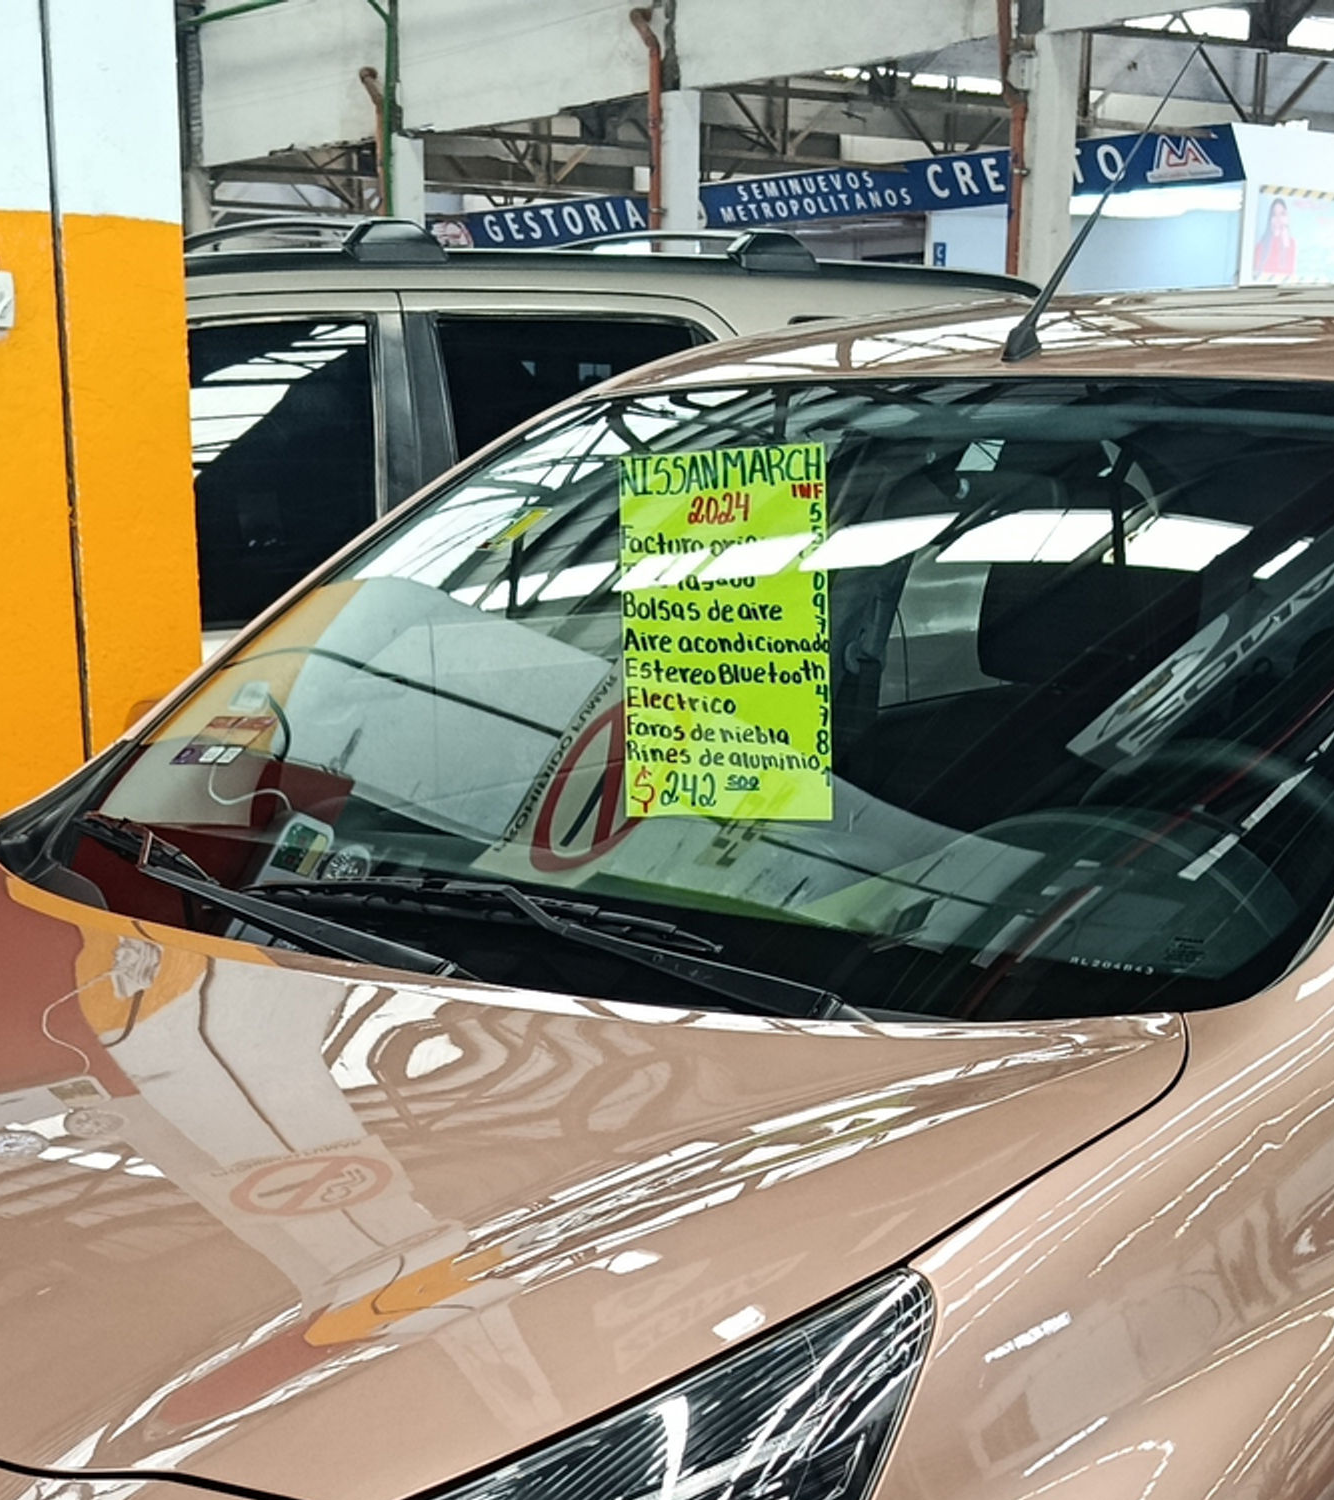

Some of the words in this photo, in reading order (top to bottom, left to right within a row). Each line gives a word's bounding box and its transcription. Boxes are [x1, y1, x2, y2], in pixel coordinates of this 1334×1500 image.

[737, 170, 875, 201] SEMINUEVOS
[483, 199, 647, 243] GESTORIA
[719, 188, 912, 223] METROPOLITANOS
[621, 450, 717, 496] NISSAN
[721, 446, 822, 488] MARCH
[687, 491, 751, 524] 2024
[623, 591, 701, 621] Bolsas
[707, 599, 734, 622] de
[737, 602, 783, 621] aire
[624, 628, 673, 653] Aire
[678, 632, 830, 653] acondicionado
[626, 657, 716, 685] Estereo
[718, 659, 825, 685] Bluetooth
[627, 686, 737, 714] Electrico
[627, 714, 685, 741] Faros
[690, 723, 716, 742] de
[721, 726, 789, 745] niebla
[627, 740, 691, 764] Rines
[699, 749, 724, 767] de
[729, 752, 821, 770] aluminio
[724, 775, 761, 791] 500
